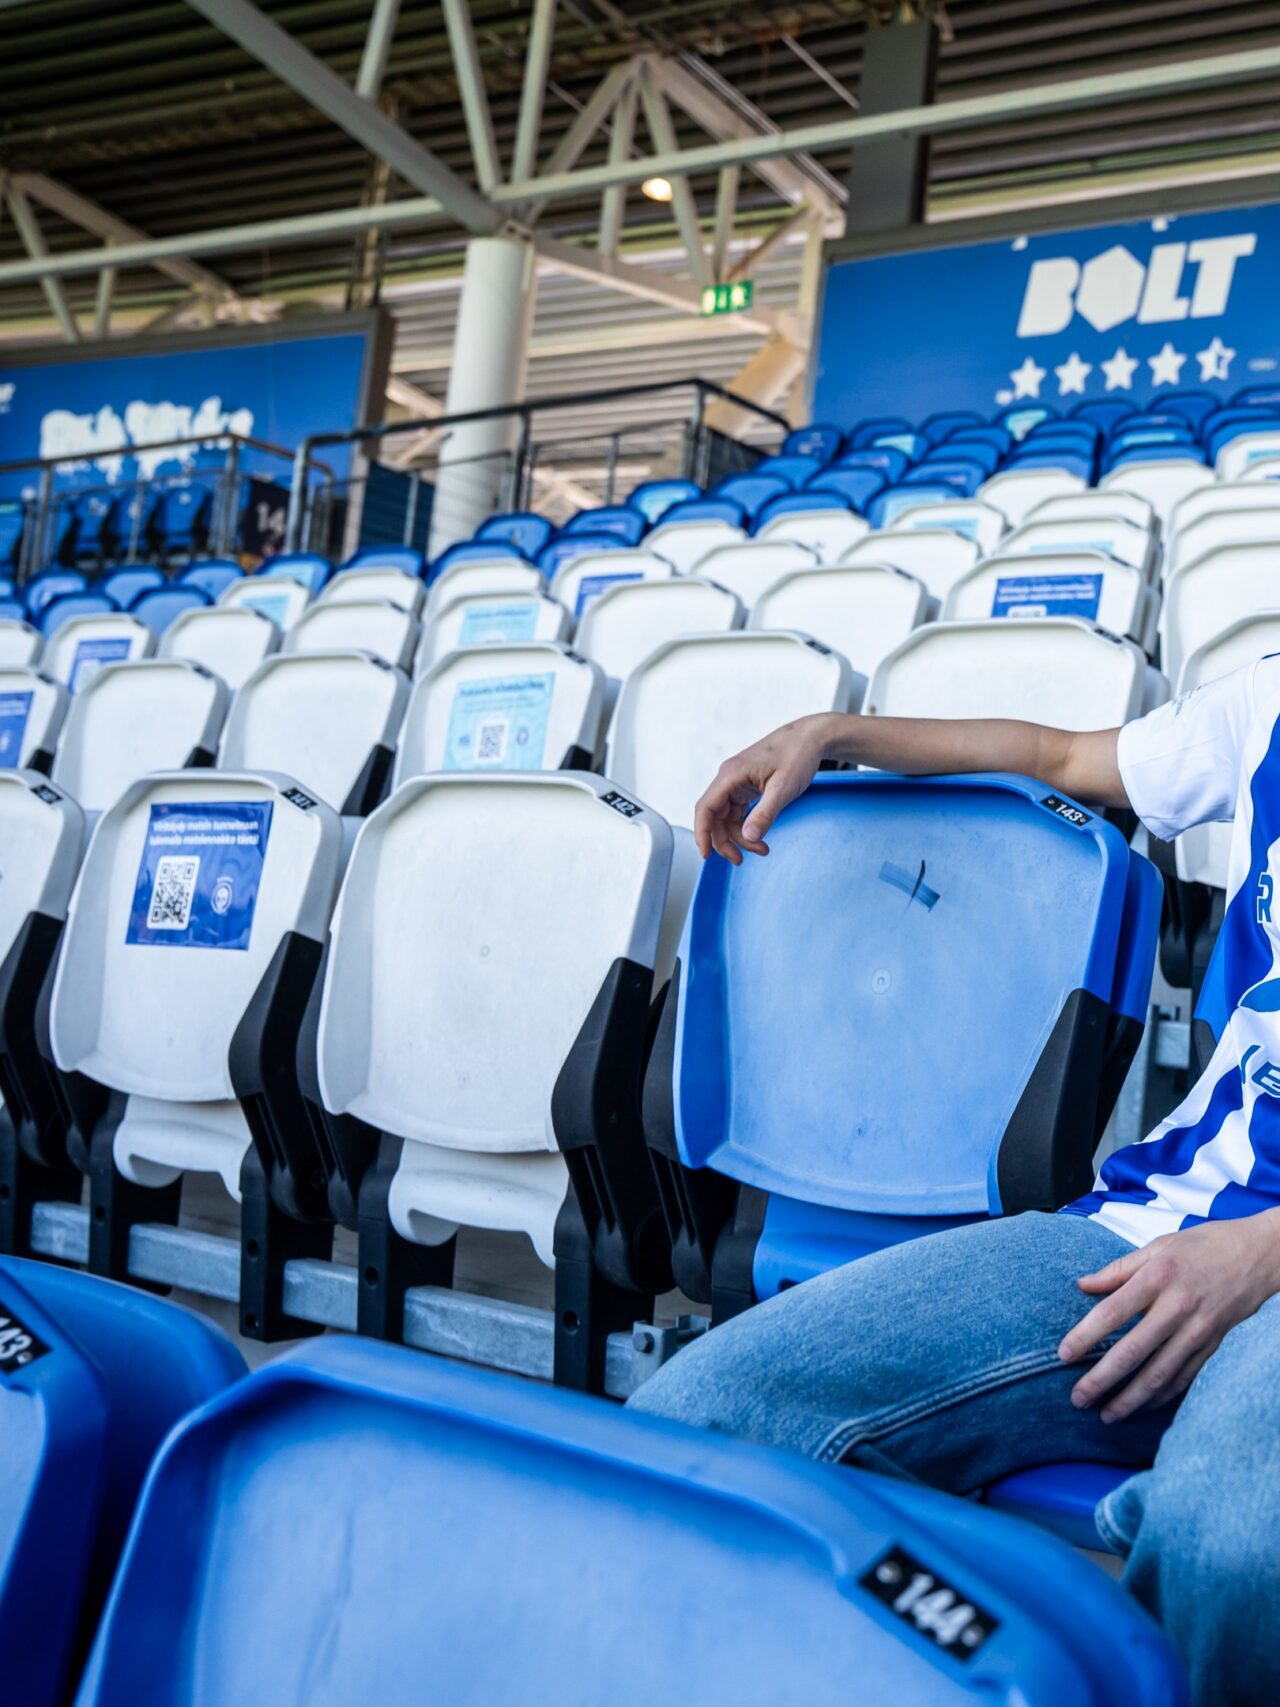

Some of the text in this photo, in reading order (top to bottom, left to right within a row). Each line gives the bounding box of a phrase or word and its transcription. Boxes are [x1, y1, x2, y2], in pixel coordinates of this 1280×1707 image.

[1016, 233, 1257, 338] BOLT
[610, 797, 635, 813] 142
[1055, 804, 1083, 821] 143
[894, 1572, 976, 1645] 144
